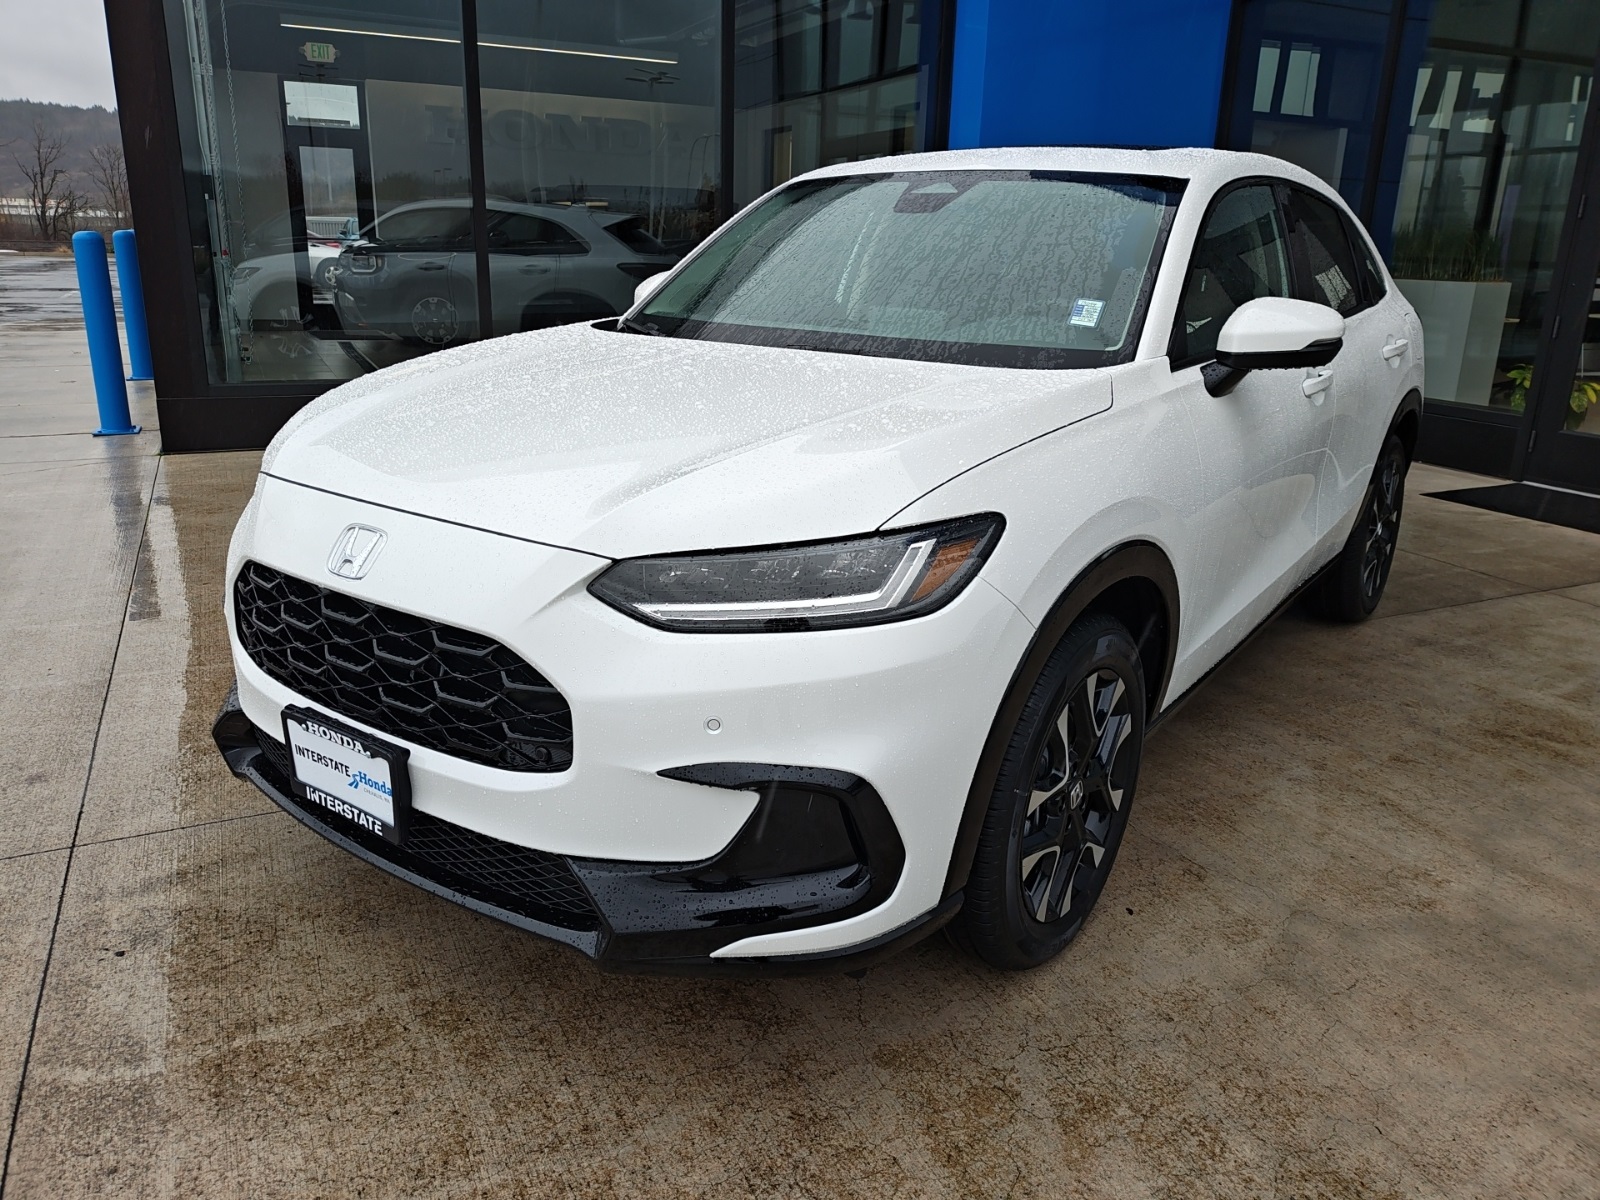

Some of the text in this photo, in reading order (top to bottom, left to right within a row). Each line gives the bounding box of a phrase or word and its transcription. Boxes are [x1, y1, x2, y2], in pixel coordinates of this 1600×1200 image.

[310, 43, 330, 60] EXIT
[306, 721, 366, 753] HONDA
[295, 744, 351, 777] INTERSTATE
[358, 771, 392, 797] Honda
[306, 786, 383, 836] INTERSTATE
